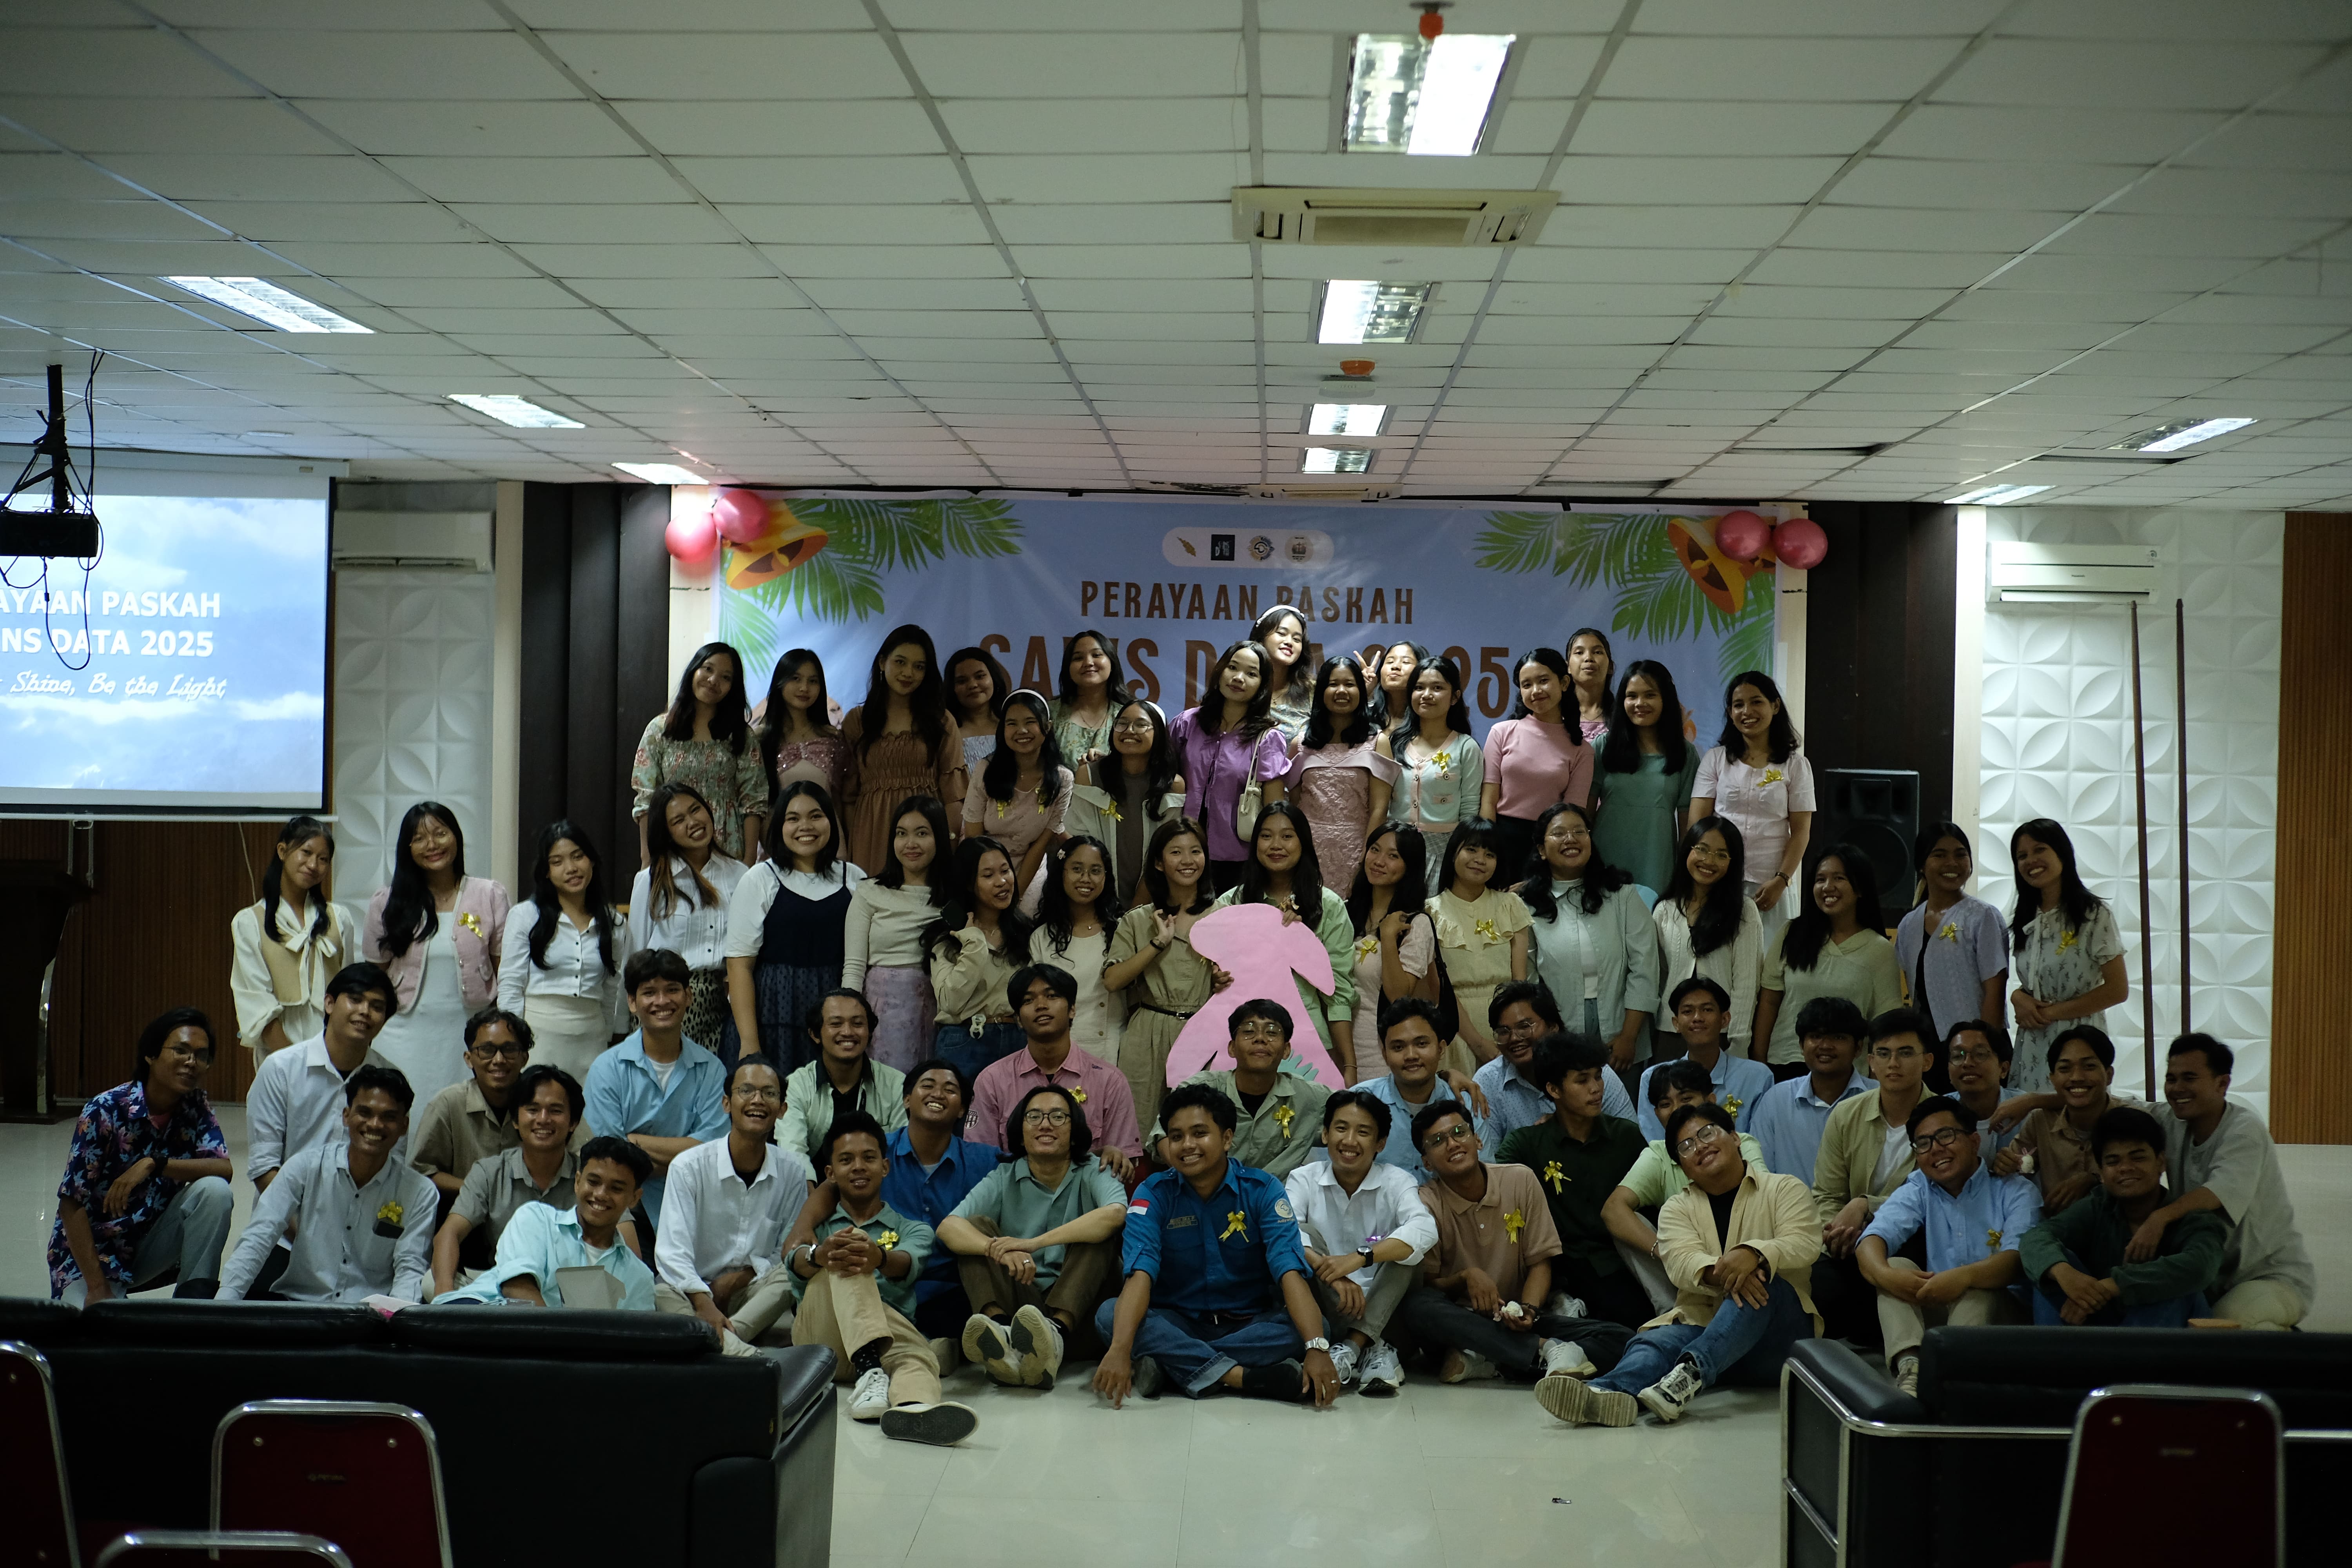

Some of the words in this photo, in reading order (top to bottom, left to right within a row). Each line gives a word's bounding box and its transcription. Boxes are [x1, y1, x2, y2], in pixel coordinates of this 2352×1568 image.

[102, 591, 220, 618] PASKAH
[1081, 581, 1258, 620] PERAYAAN
[51, 628, 131, 654] DATA
[140, 630, 214, 657] 2025
[979, 633, 1160, 705] SAS
[10, 670, 75, 696] Shine,
[88, 672, 116, 695] Be
[125, 675, 159, 697] the
[166, 673, 227, 702] Light
